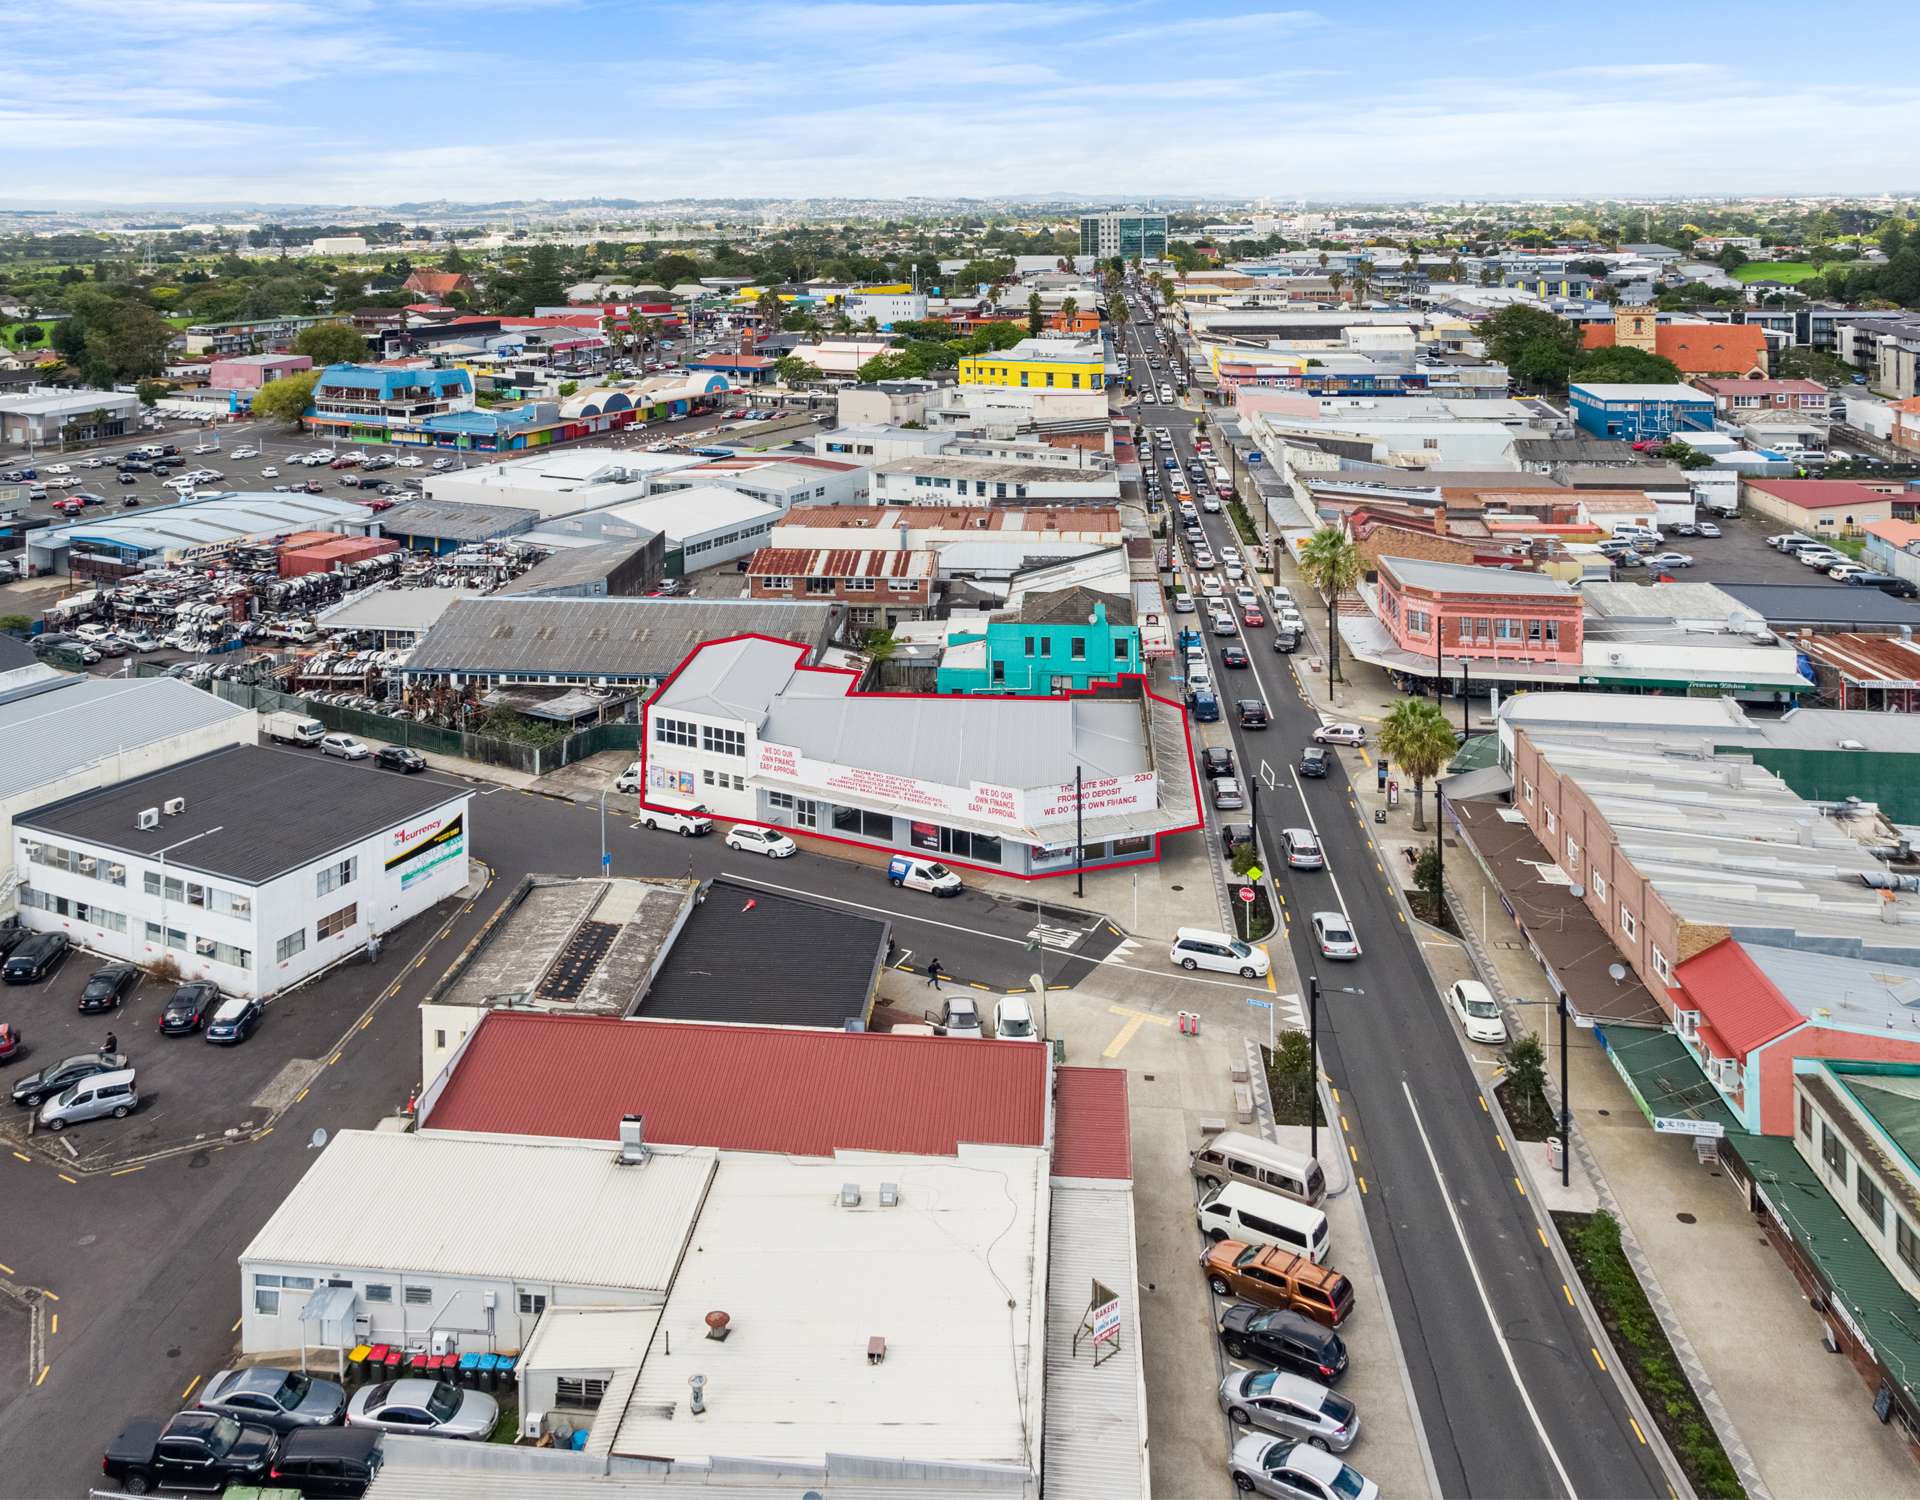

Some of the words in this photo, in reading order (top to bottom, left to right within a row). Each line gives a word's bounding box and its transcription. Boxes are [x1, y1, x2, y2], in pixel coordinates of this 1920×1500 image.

[764, 746, 773, 754] WE
[773, 748, 781, 756] DO
[762, 754, 773, 762] OWN
[774, 757, 796, 767] FINANCE
[760, 762, 773, 770] EASY
[773, 765, 799, 776] APPROVAL
[829, 778, 873, 789] COMPUTERS
[841, 775, 884, 788] HOUSEHOLD
[885, 784, 927, 795] FURNITURE
[868, 776, 896, 785] SCREEN
[886, 775, 917, 784] DEPOSIT
[1079, 781, 1097, 790] UITE
[1099, 778, 1118, 787] SHOP
[1134, 773, 1153, 783] 230
[826, 781, 858, 792] WASHING
[860, 787, 897, 799] MACHINES
[978, 788, 990, 796] WE
[990, 790, 999, 798] DO
[1000, 791, 1013, 800] OUR
[1057, 793, 1079, 803] FROM
[1080, 792, 1090, 800] NO
[1092, 787, 1122, 798] DEPOSIT
[975, 796, 988, 804] OWN
[990, 798, 1015, 810] FINANCE
[1044, 808, 1056, 816] WE
[1058, 806, 1069, 814] DO
[1071, 803, 1086, 812] OR
[1088, 800, 1105, 809] OWN
[1107, 796, 1137, 807] FINANCE
[968, 803, 982, 812] EASY
[988, 807, 1017, 819] APPROVAL
[405, 820, 442, 841] currency
[1095, 1301, 1119, 1320] BAKERY
